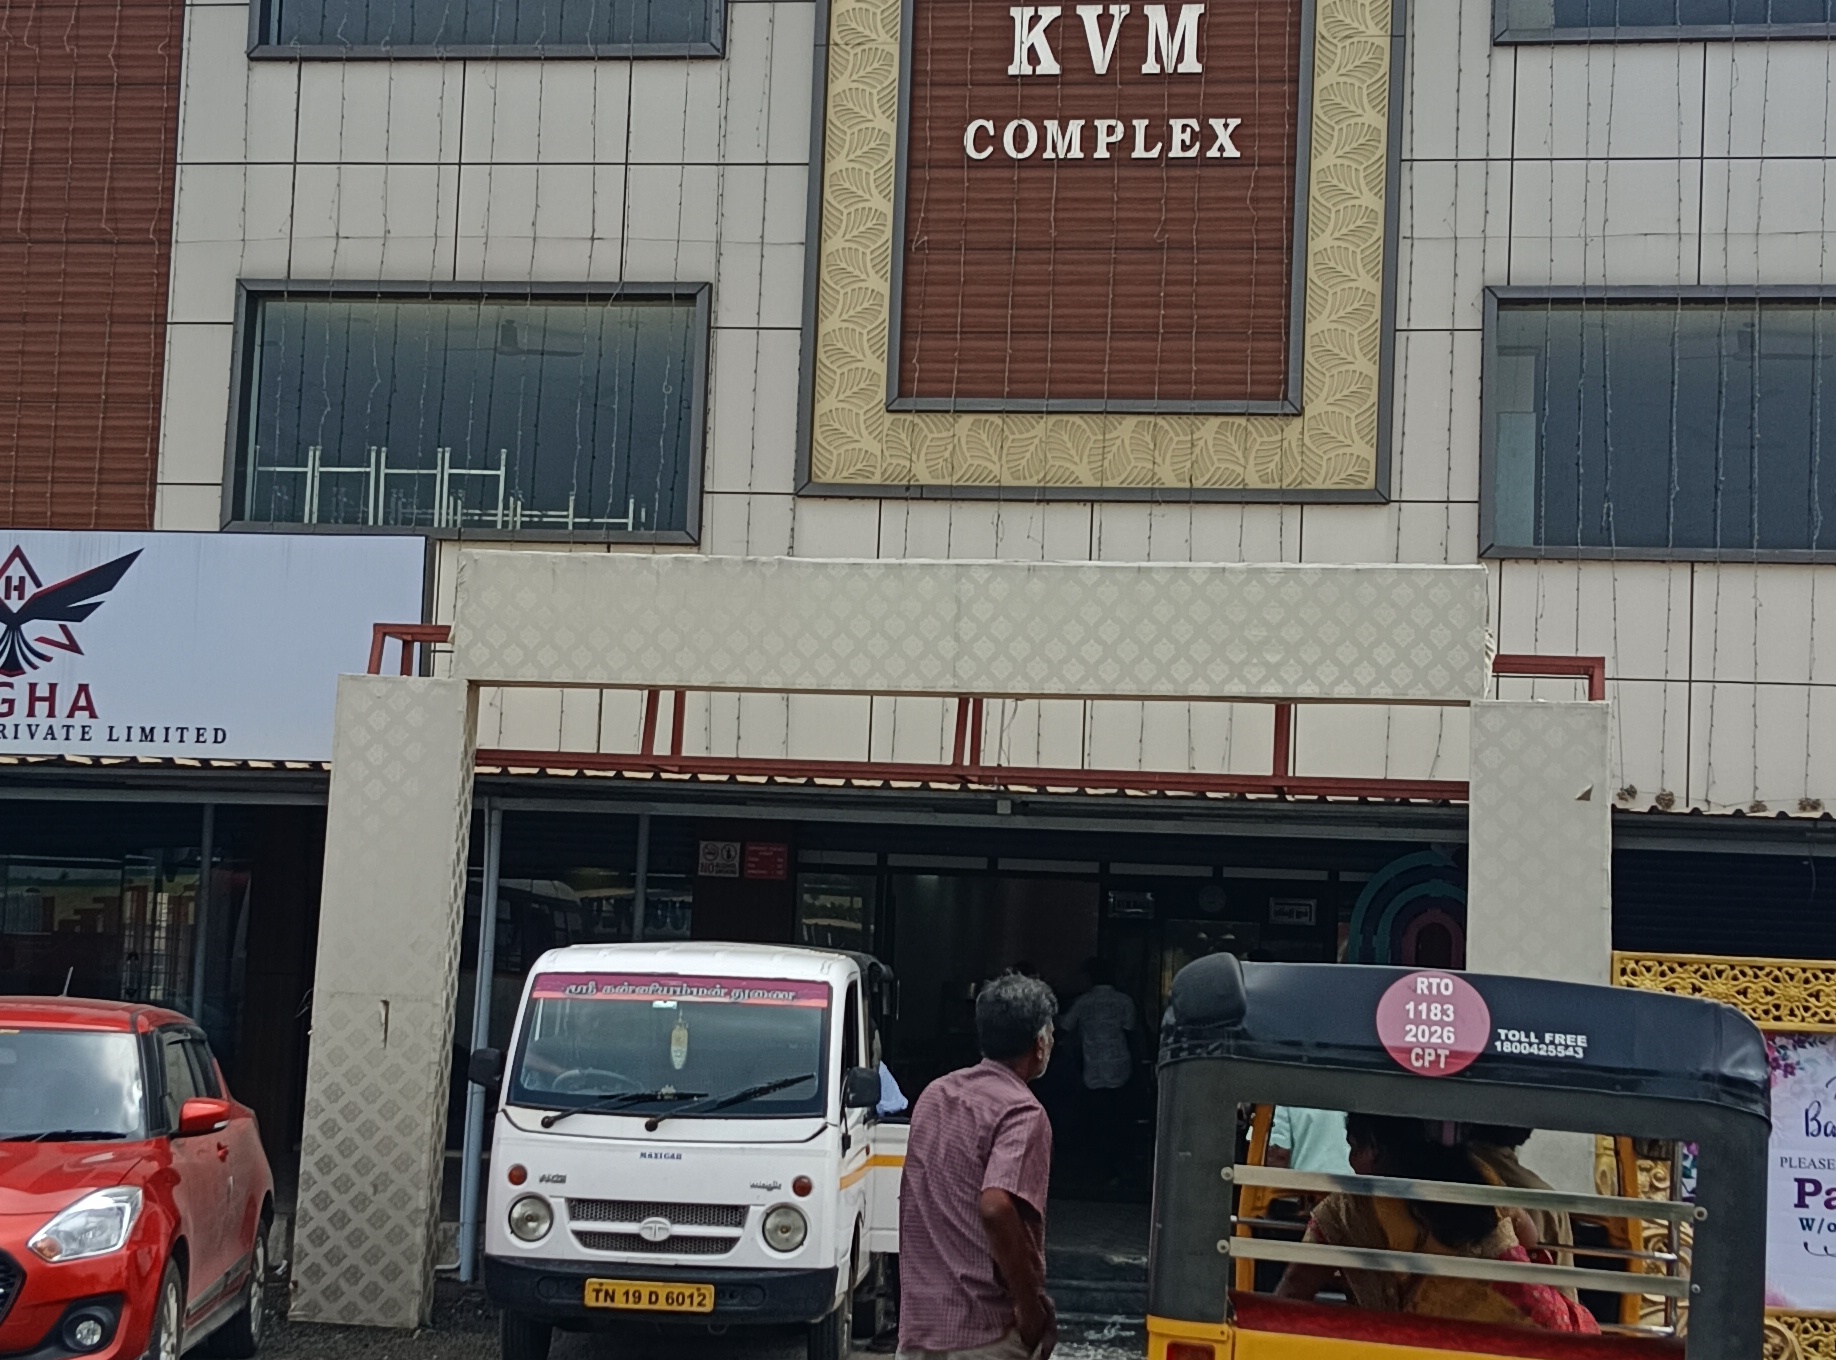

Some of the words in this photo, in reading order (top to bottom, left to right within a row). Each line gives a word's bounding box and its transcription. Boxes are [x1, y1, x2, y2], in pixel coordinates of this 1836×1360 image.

[1008, 3, 1205, 76] KVM
[963, 118, 1242, 160] COMPLEX
[107, 725, 228, 745] LIMITED
[1416, 977, 1453, 996] RTO
[1405, 1001, 1455, 1022] 1183
[1404, 1024, 1455, 1044] 2026
[1497, 1029, 1539, 1043] TOLL
[1544, 1032, 1588, 1048] FREE
[1411, 1047, 1450, 1069] CPT
[1779, 1156, 1836, 1171] PLEASE
[592, 1288, 616, 1304] TN
[623, 1289, 642, 1304] 19
[648, 1290, 660, 1305] D
[665, 1290, 707, 1308] 6012
